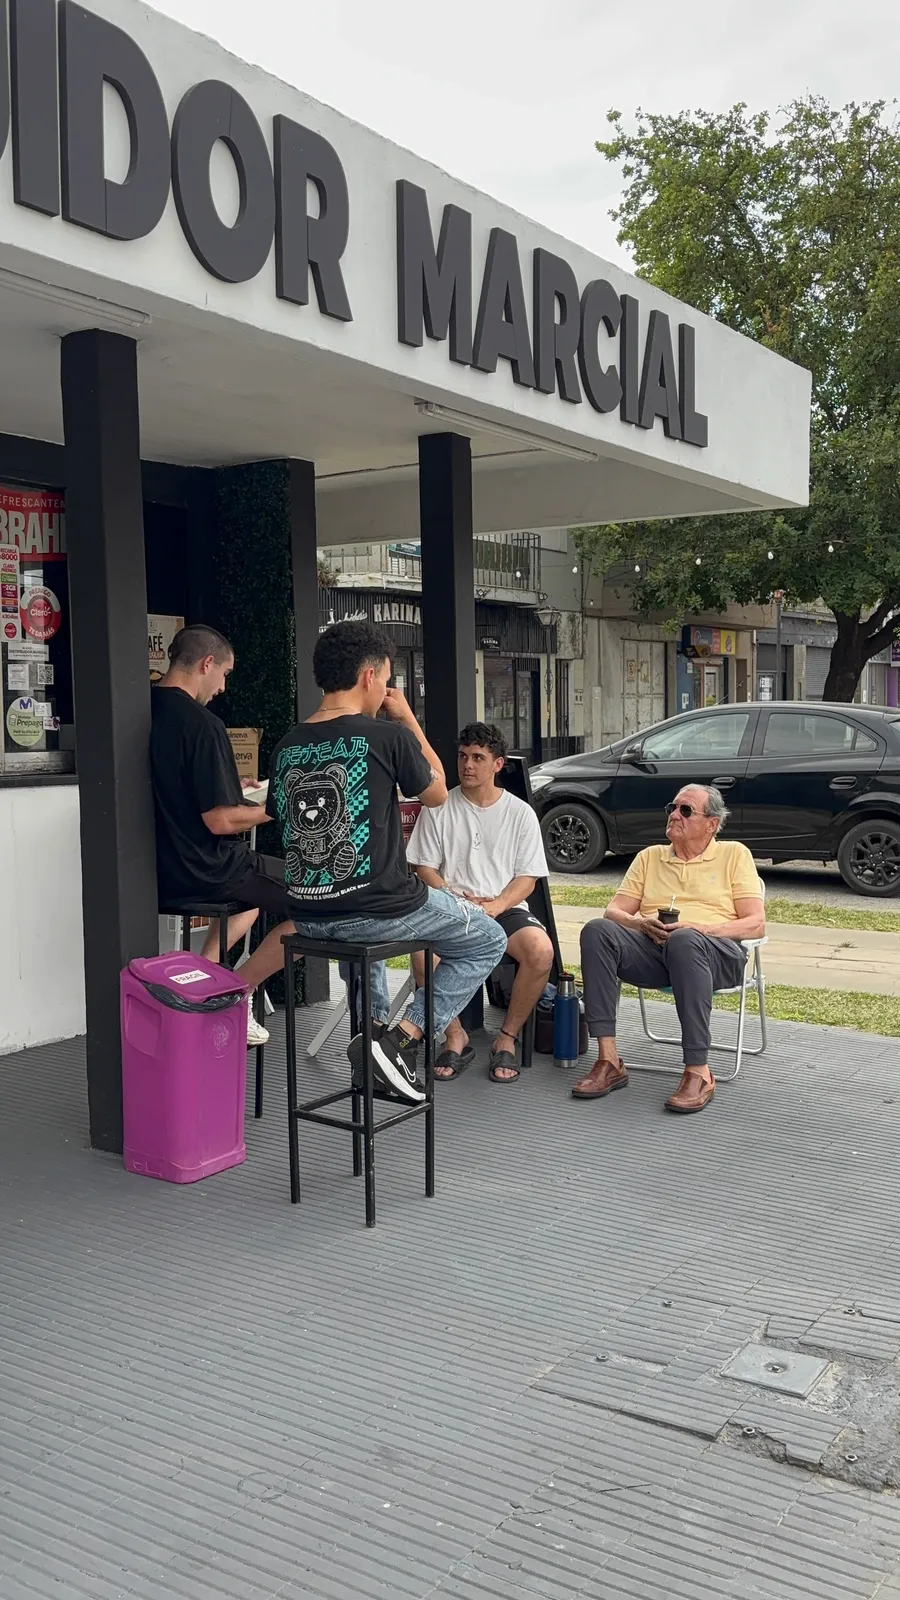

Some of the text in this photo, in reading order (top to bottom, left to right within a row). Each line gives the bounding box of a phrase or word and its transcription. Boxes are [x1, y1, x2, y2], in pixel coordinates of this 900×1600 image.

[0, 0, 708, 448] IDOR MARCIAL
[373, 603, 422, 625] KARINA
[340, 886, 357, 895] BLACK
